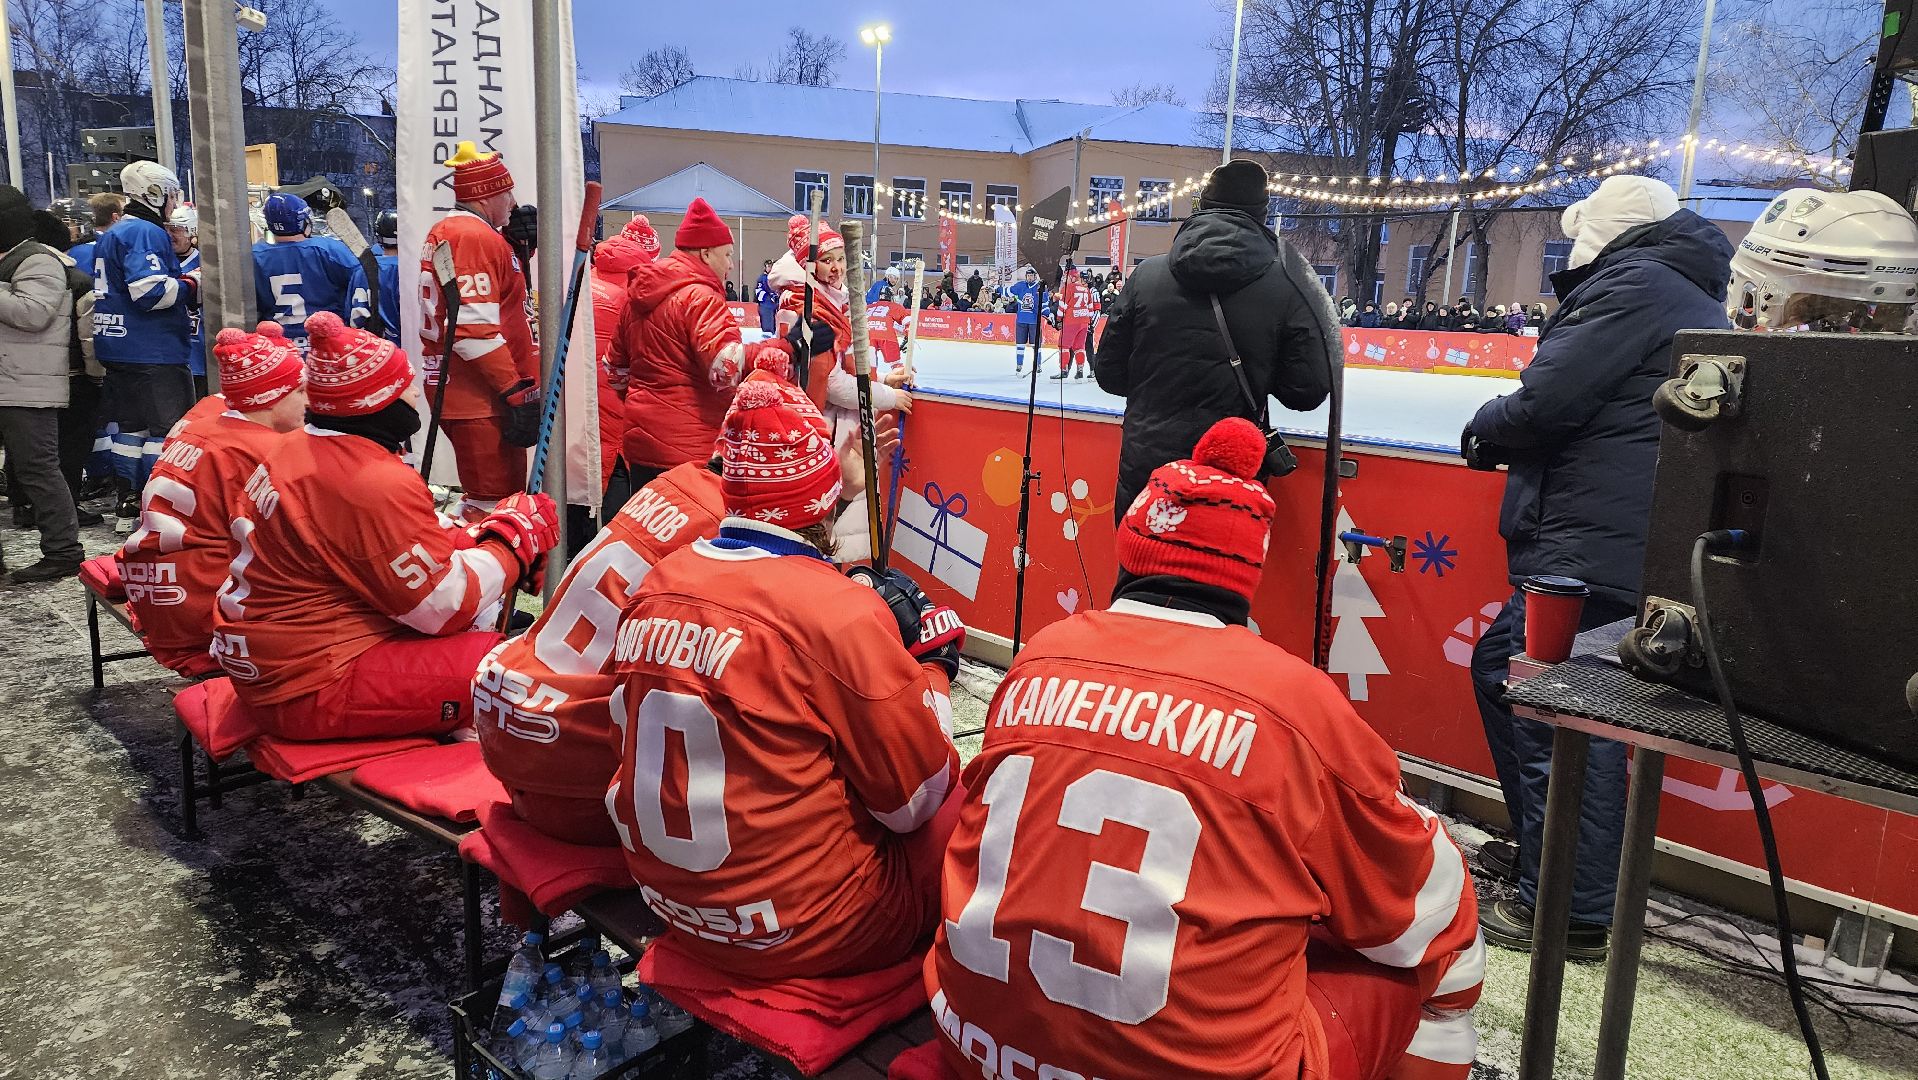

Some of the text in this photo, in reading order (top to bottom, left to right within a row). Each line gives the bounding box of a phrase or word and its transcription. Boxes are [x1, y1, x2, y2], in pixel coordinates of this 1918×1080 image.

[145, 253, 162, 271] 3
[1740, 239, 1772, 257] BAUER
[1874, 265, 1918, 276] BAUE
[268, 273, 308, 326] 5
[418, 271, 440, 343] 8
[457, 272, 491, 298] 28
[858, 389, 871, 442] CCM
[618, 487, 689, 543] СЬКОВ
[389, 542, 445, 590] 51
[994, 675, 1258, 778] КАМЕНСКИЙ
[945, 754, 1203, 1026] 13
